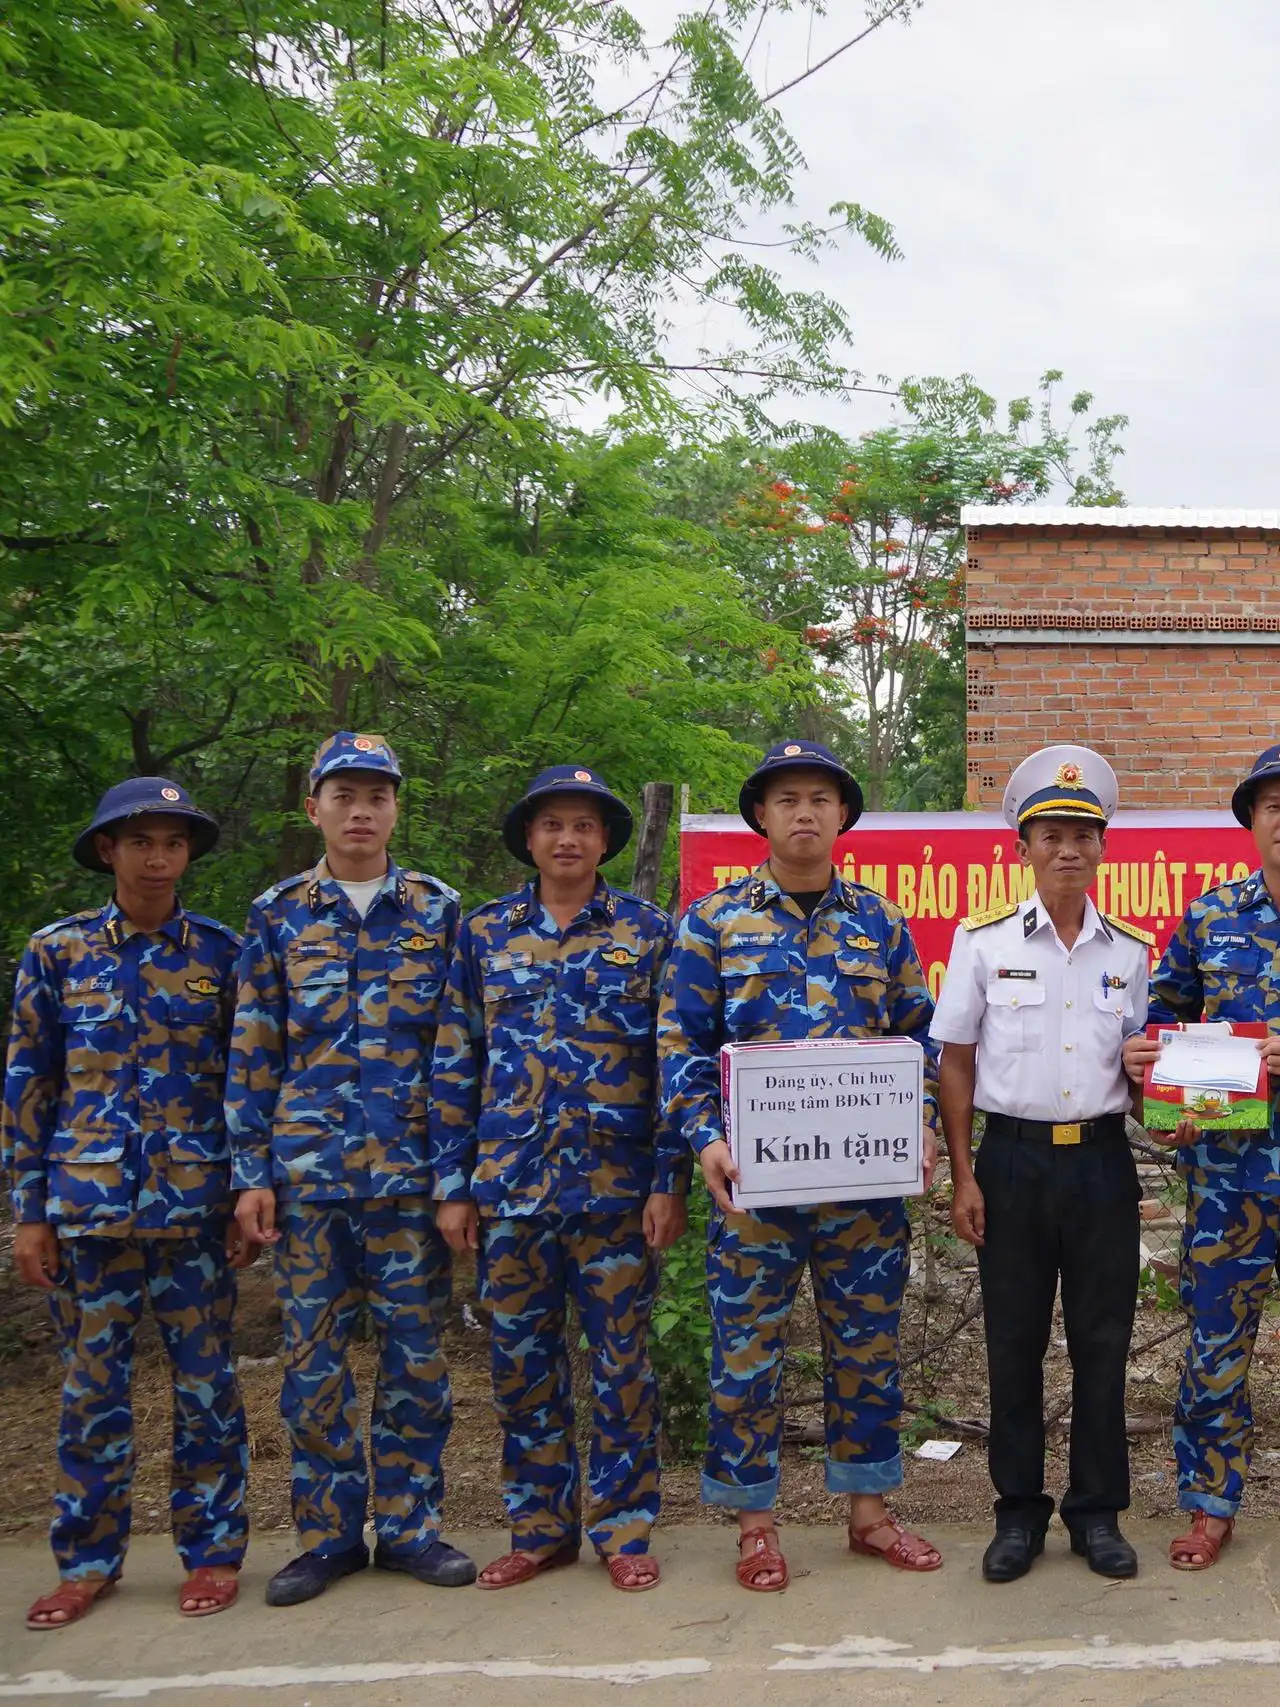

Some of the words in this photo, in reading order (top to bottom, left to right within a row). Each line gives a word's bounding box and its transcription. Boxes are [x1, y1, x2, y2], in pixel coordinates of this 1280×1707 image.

[897, 845, 958, 919] BẢO
[967, 845, 1036, 917] ĐẢM
[1096, 849, 1187, 929] THUẬT
[870, 1071, 897, 1087] huy
[747, 1097, 796, 1113] Trung
[801, 1096, 829, 1110] tâm
[835, 1092, 885, 1108] BĐKT
[888, 1090, 914, 1105] 719
[752, 1134, 831, 1165] Kính
[843, 1132, 910, 1166] tặng
